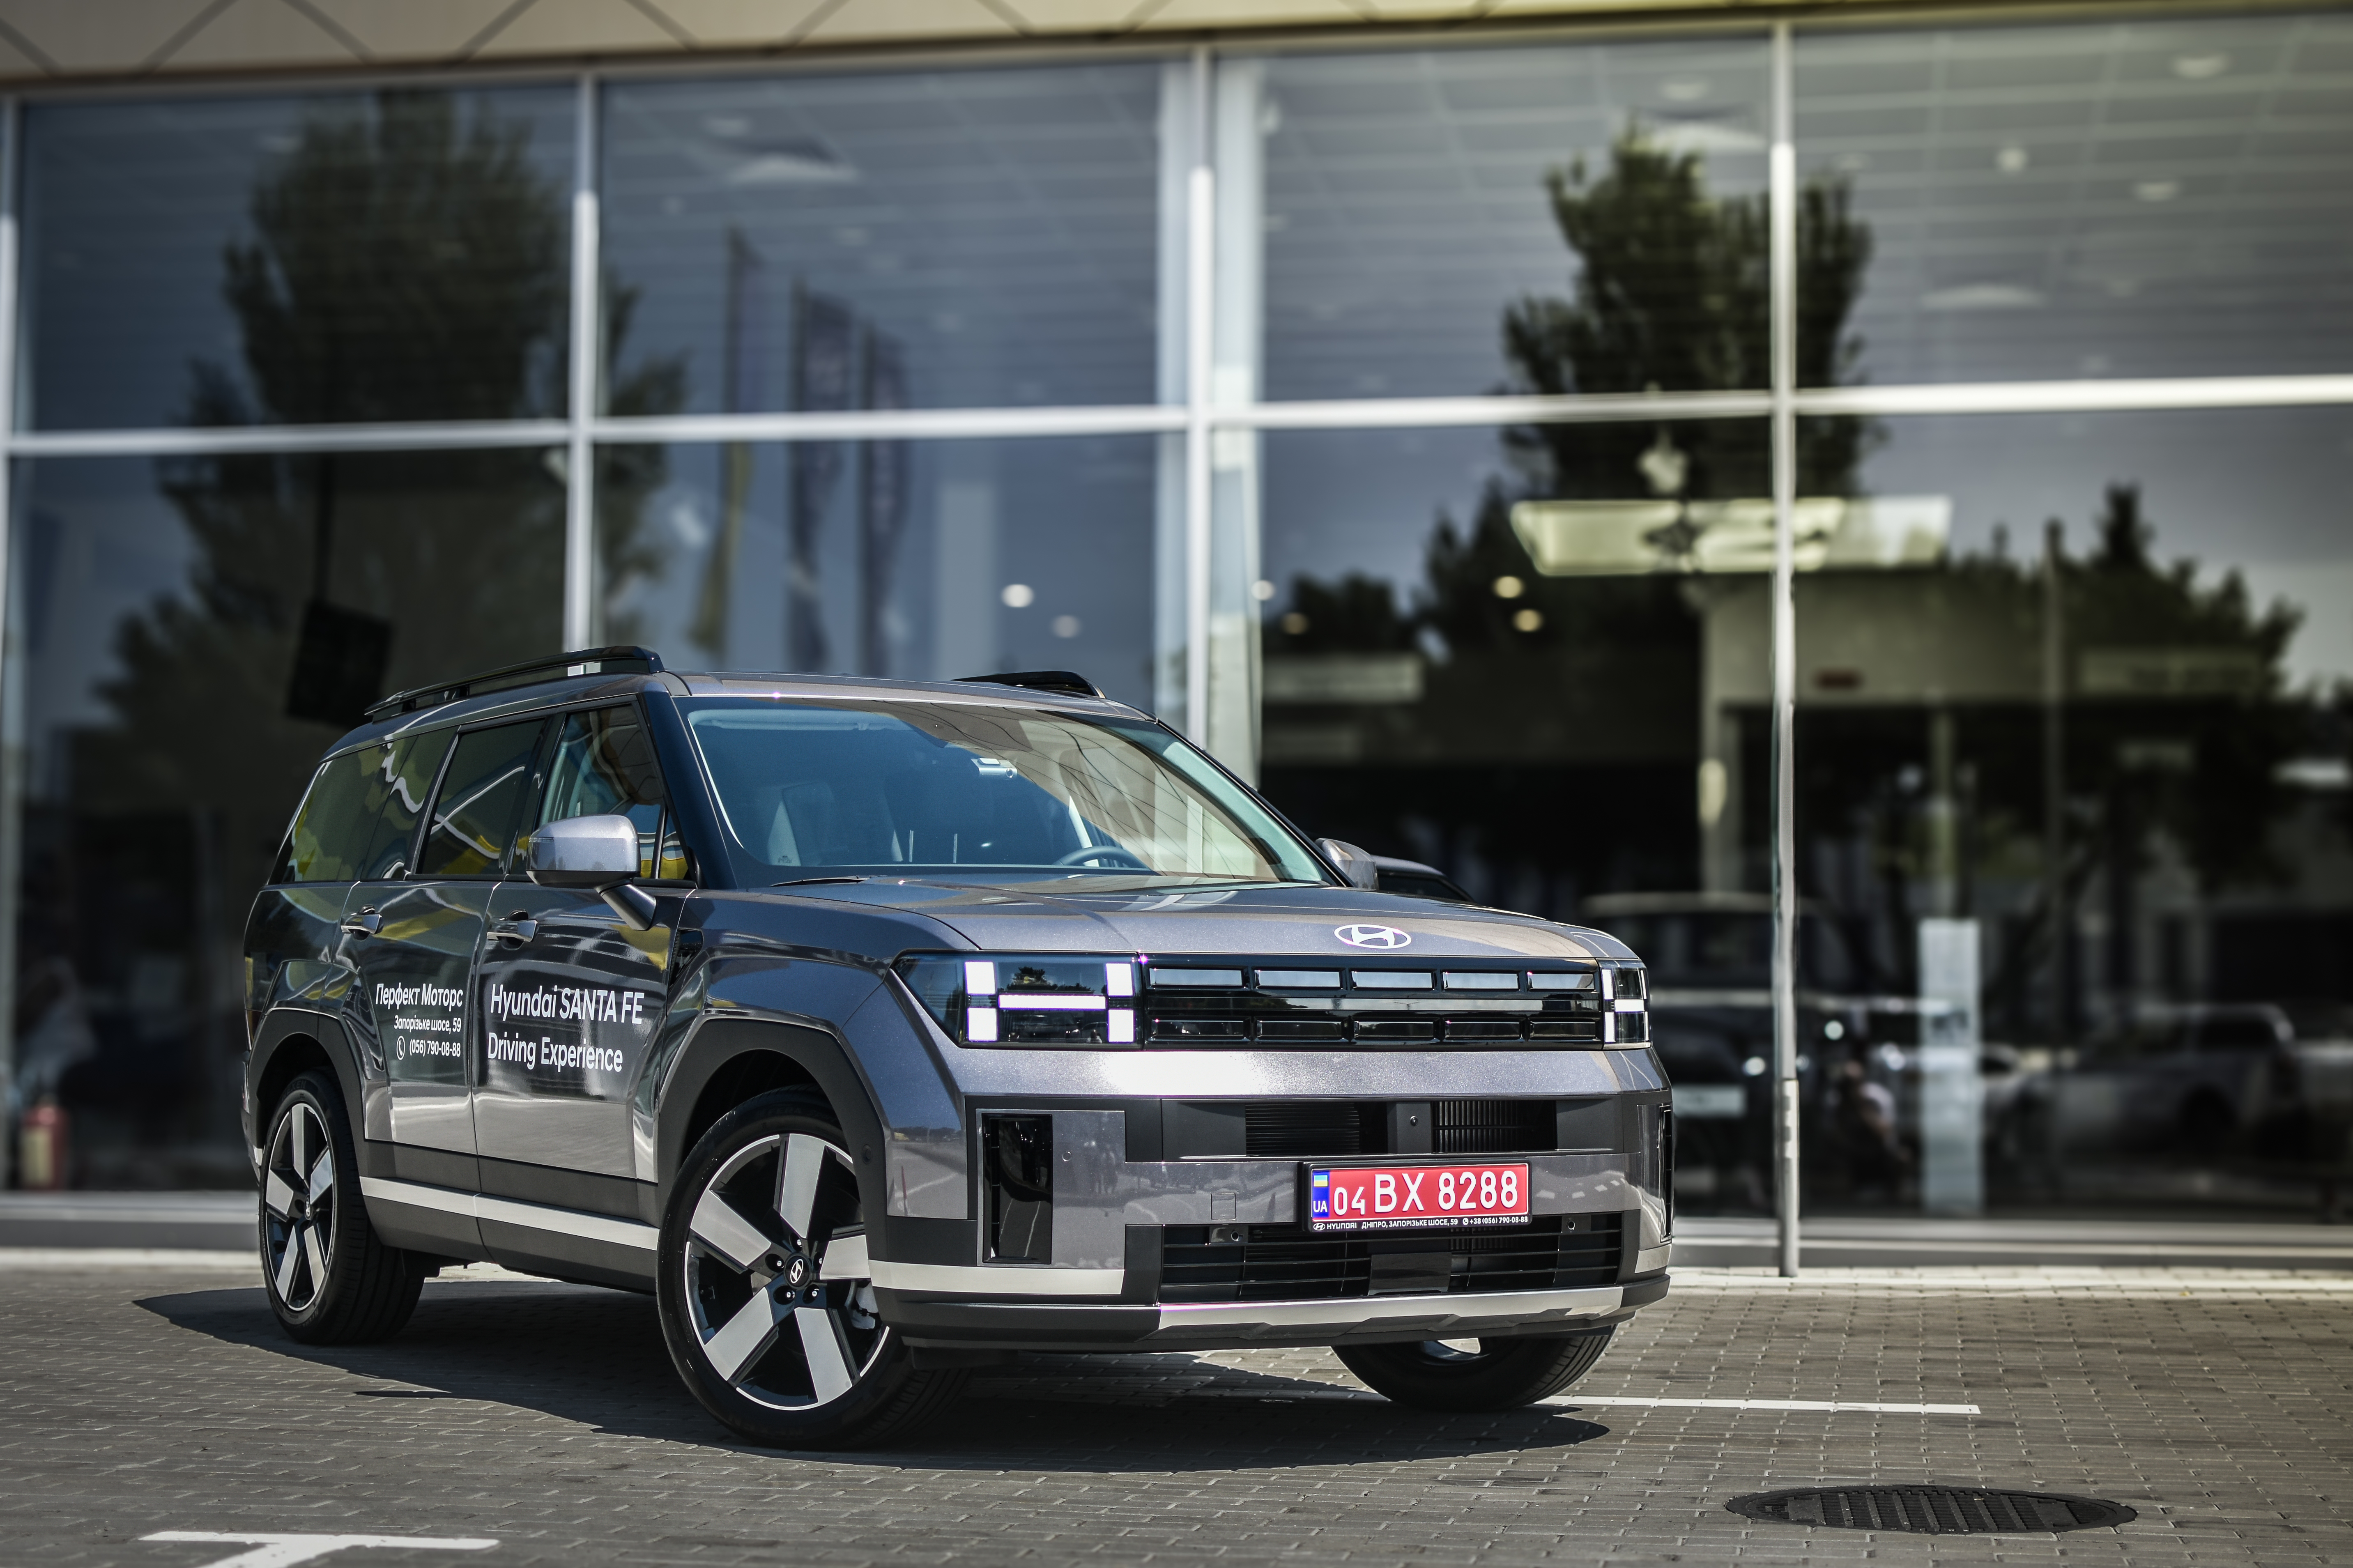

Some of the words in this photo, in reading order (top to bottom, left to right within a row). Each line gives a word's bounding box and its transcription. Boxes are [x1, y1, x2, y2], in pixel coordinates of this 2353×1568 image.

[376, 982, 420, 1009] Перфект
[421, 983, 463, 1012] Моторс
[491, 984, 557, 1021] Hyundai
[559, 987, 616, 1022] SANTA
[621, 991, 645, 1024] FE
[394, 1014, 430, 1032] Запорізьке
[431, 1019, 451, 1034] шосе,
[452, 1017, 461, 1032] 59
[409, 1039, 426, 1057] (056)
[427, 1040, 461, 1057] 790-08-88
[488, 1032, 536, 1070] Driving
[541, 1037, 623, 1072] Experience
[1334, 1186, 1366, 1215] 04
[1374, 1173, 1425, 1213] BX
[1438, 1170, 1518, 1211] 8288
[1313, 1200, 1328, 1213] UA
[1361, 1221, 1388, 1229] ДНІПРО,
